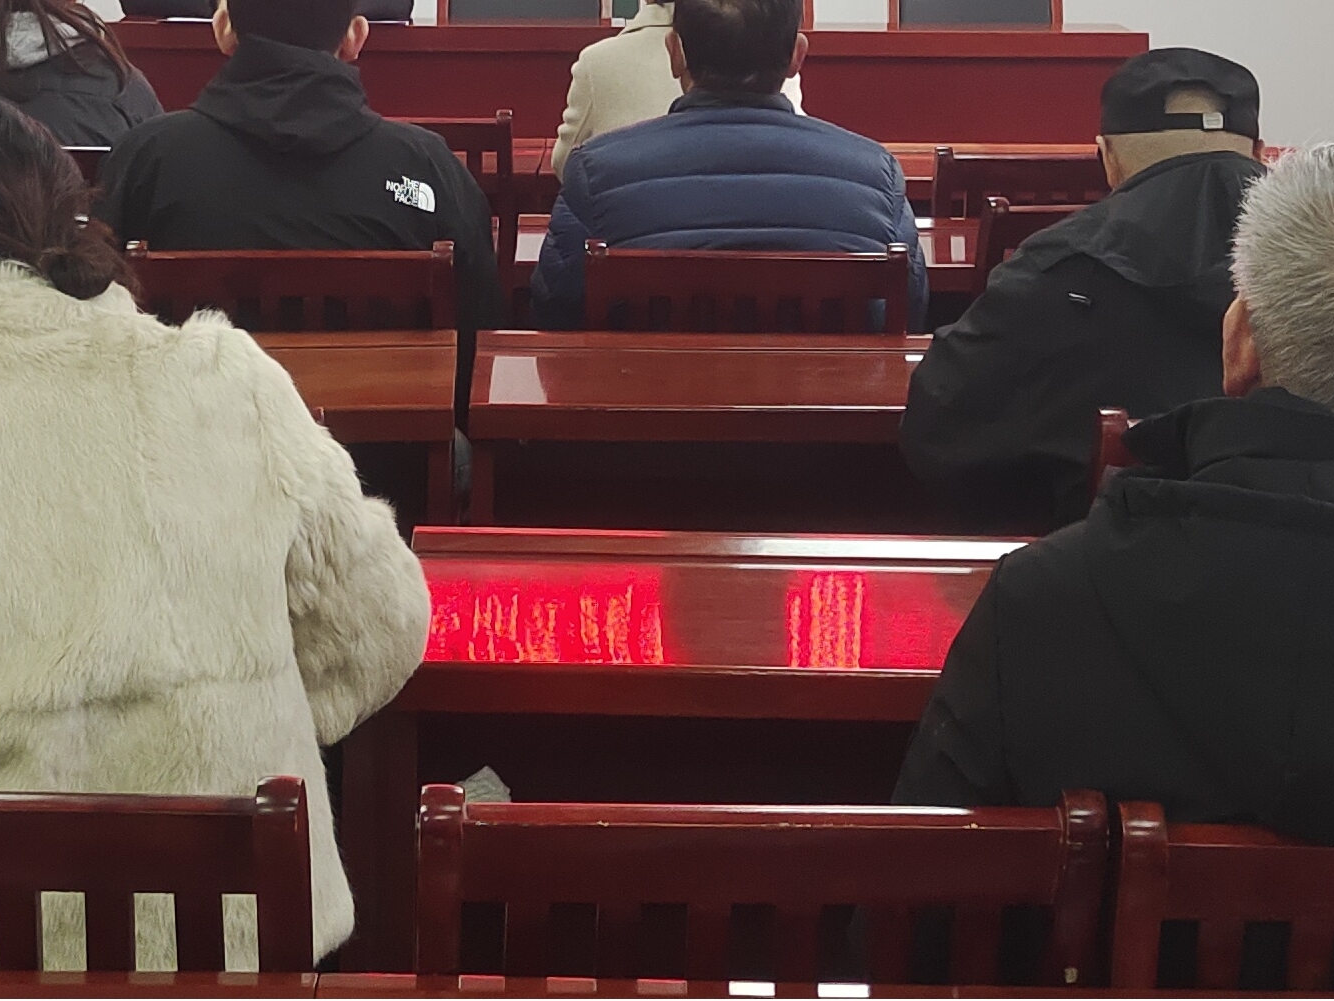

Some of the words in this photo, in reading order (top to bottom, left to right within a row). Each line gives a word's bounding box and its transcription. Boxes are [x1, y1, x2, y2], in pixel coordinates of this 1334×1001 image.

[385, 180, 420, 198] NORTH
[402, 175, 420, 189] THE
[394, 192, 419, 207] FACE
